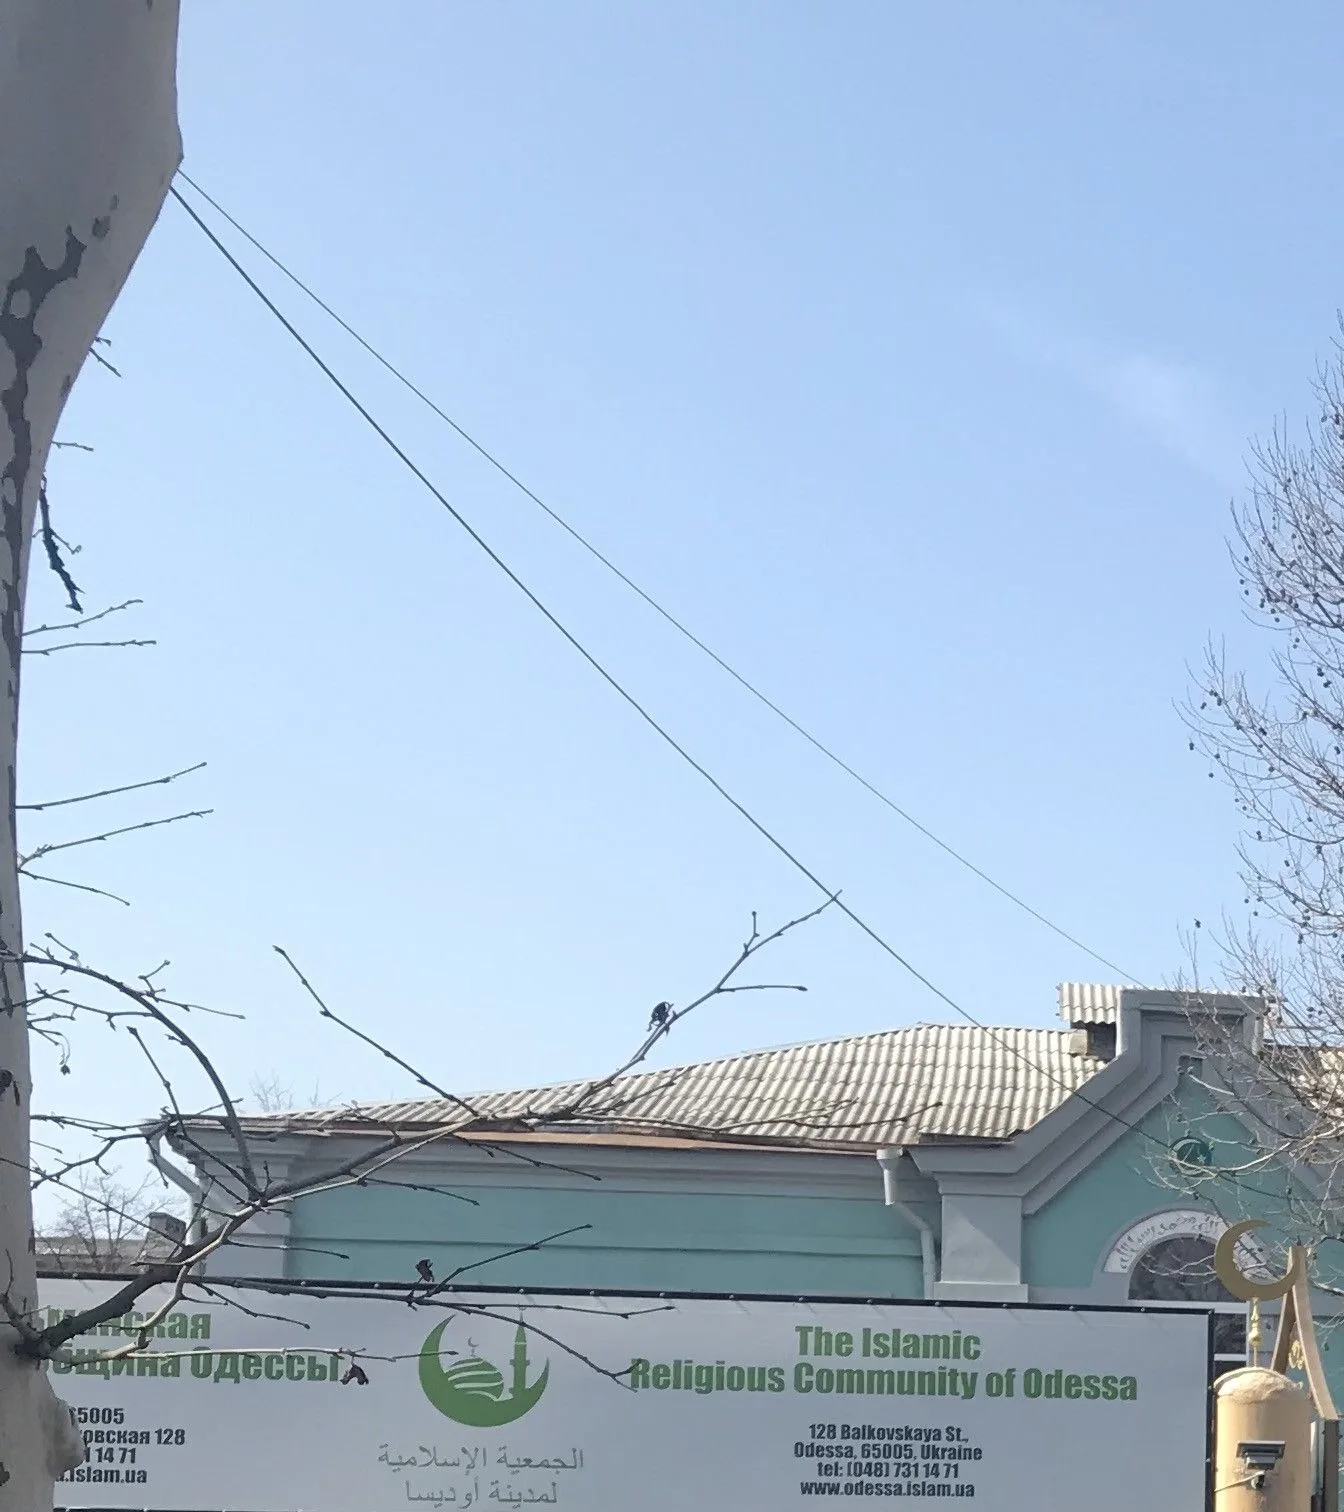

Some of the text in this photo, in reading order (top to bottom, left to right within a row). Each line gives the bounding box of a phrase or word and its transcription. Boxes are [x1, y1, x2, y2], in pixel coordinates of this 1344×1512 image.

[795, 1325, 981, 1360] The Islamic
[190, 1346, 339, 1384] Одессы
[630, 1358, 1138, 1401] Religious Community of Odessa
[154, 1428, 186, 1446] 128
[809, 1423, 837, 1440] 128
[841, 1424, 942, 1443] Balkovskaya
[95, 1447, 115, 1464] 14
[119, 1447, 137, 1464] 71
[497, 1446, 584, 1474] الجمعية
[794, 1442, 983, 1461] Odessa, 65005, Ukraine
[817, 1461, 844, 1478] tel:
[893, 1462, 919, 1479] 731
[923, 1463, 940, 1479] 14
[943, 1463, 959, 1479] 71
[488, 1480, 558, 1509] لمدينة
[800, 1480, 975, 1498] www.odessa.islam.ua
